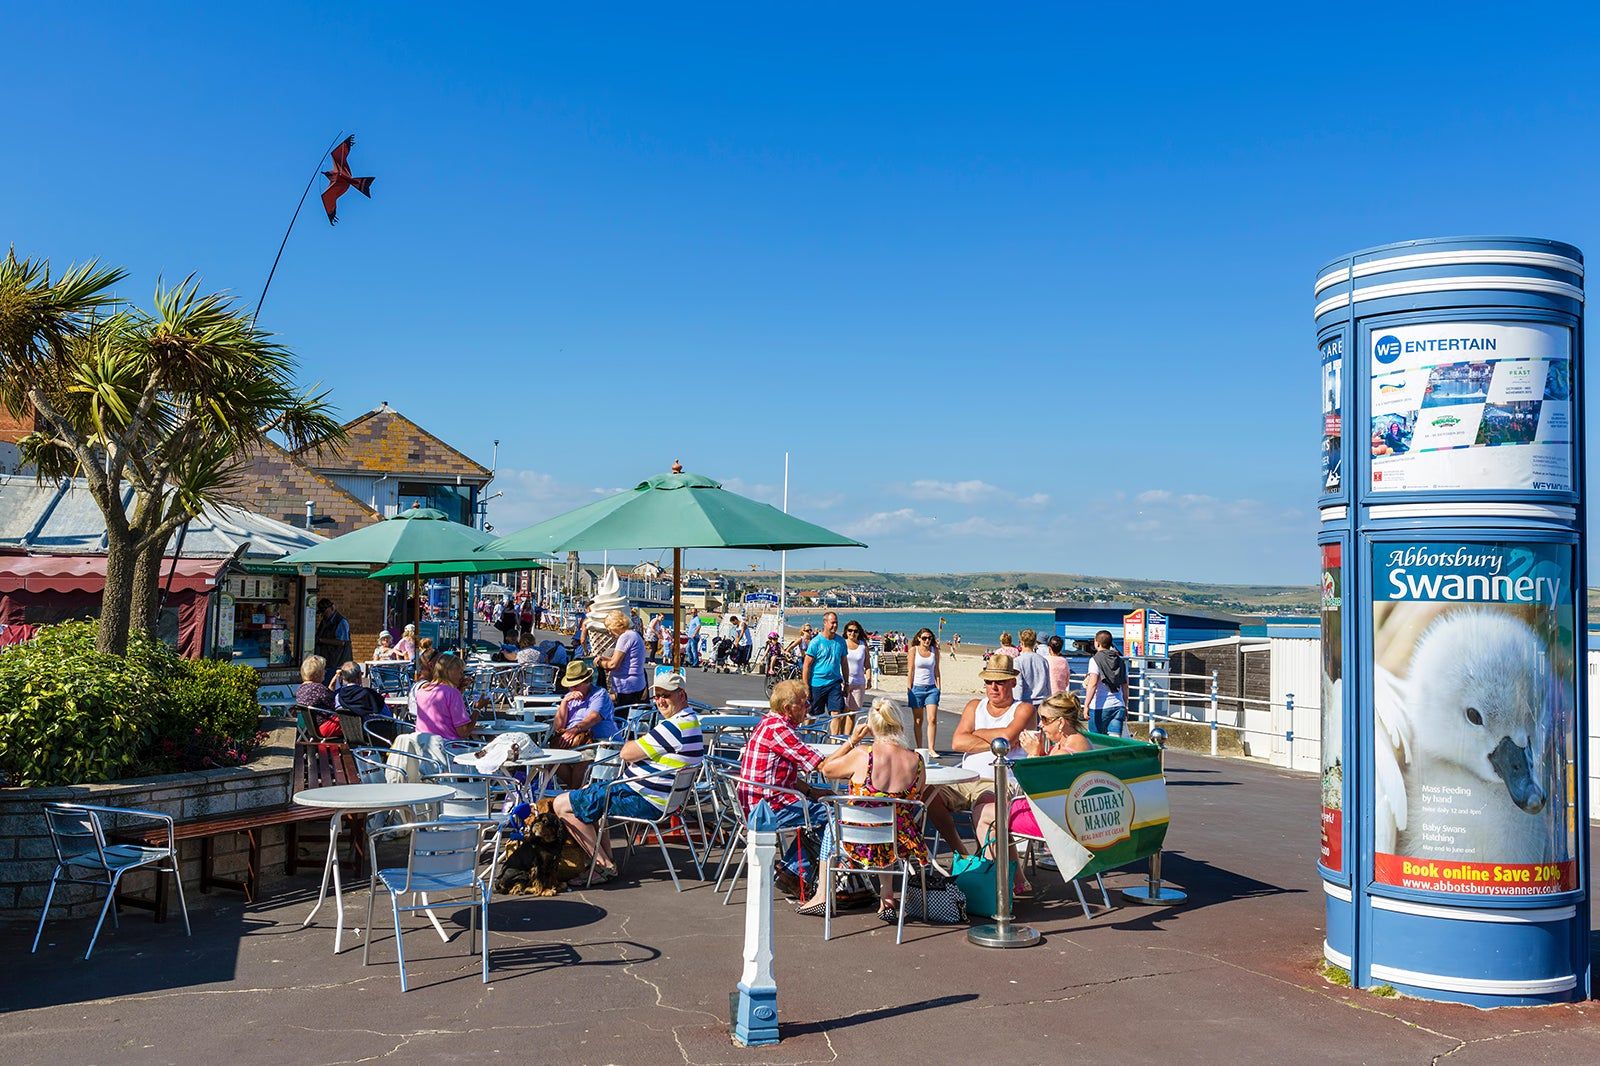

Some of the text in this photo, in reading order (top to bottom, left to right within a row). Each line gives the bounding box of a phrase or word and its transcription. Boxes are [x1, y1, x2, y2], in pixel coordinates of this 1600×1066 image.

[1405, 338, 1496, 353] ENTERTAIN
[1386, 546, 1502, 576] Abbotsbury
[1389, 568, 1560, 611] Swannery
[1422, 785, 1472, 796] Mass Feeding
[1422, 794, 1452, 804] by hand
[1074, 790, 1124, 815] CHILDHAY
[1084, 810, 1120, 831] MANOR
[1422, 823, 1466, 833] Baby Swans
[1422, 833, 1454, 844] Hatching
[1402, 861, 1561, 882] Book online Save 20%
